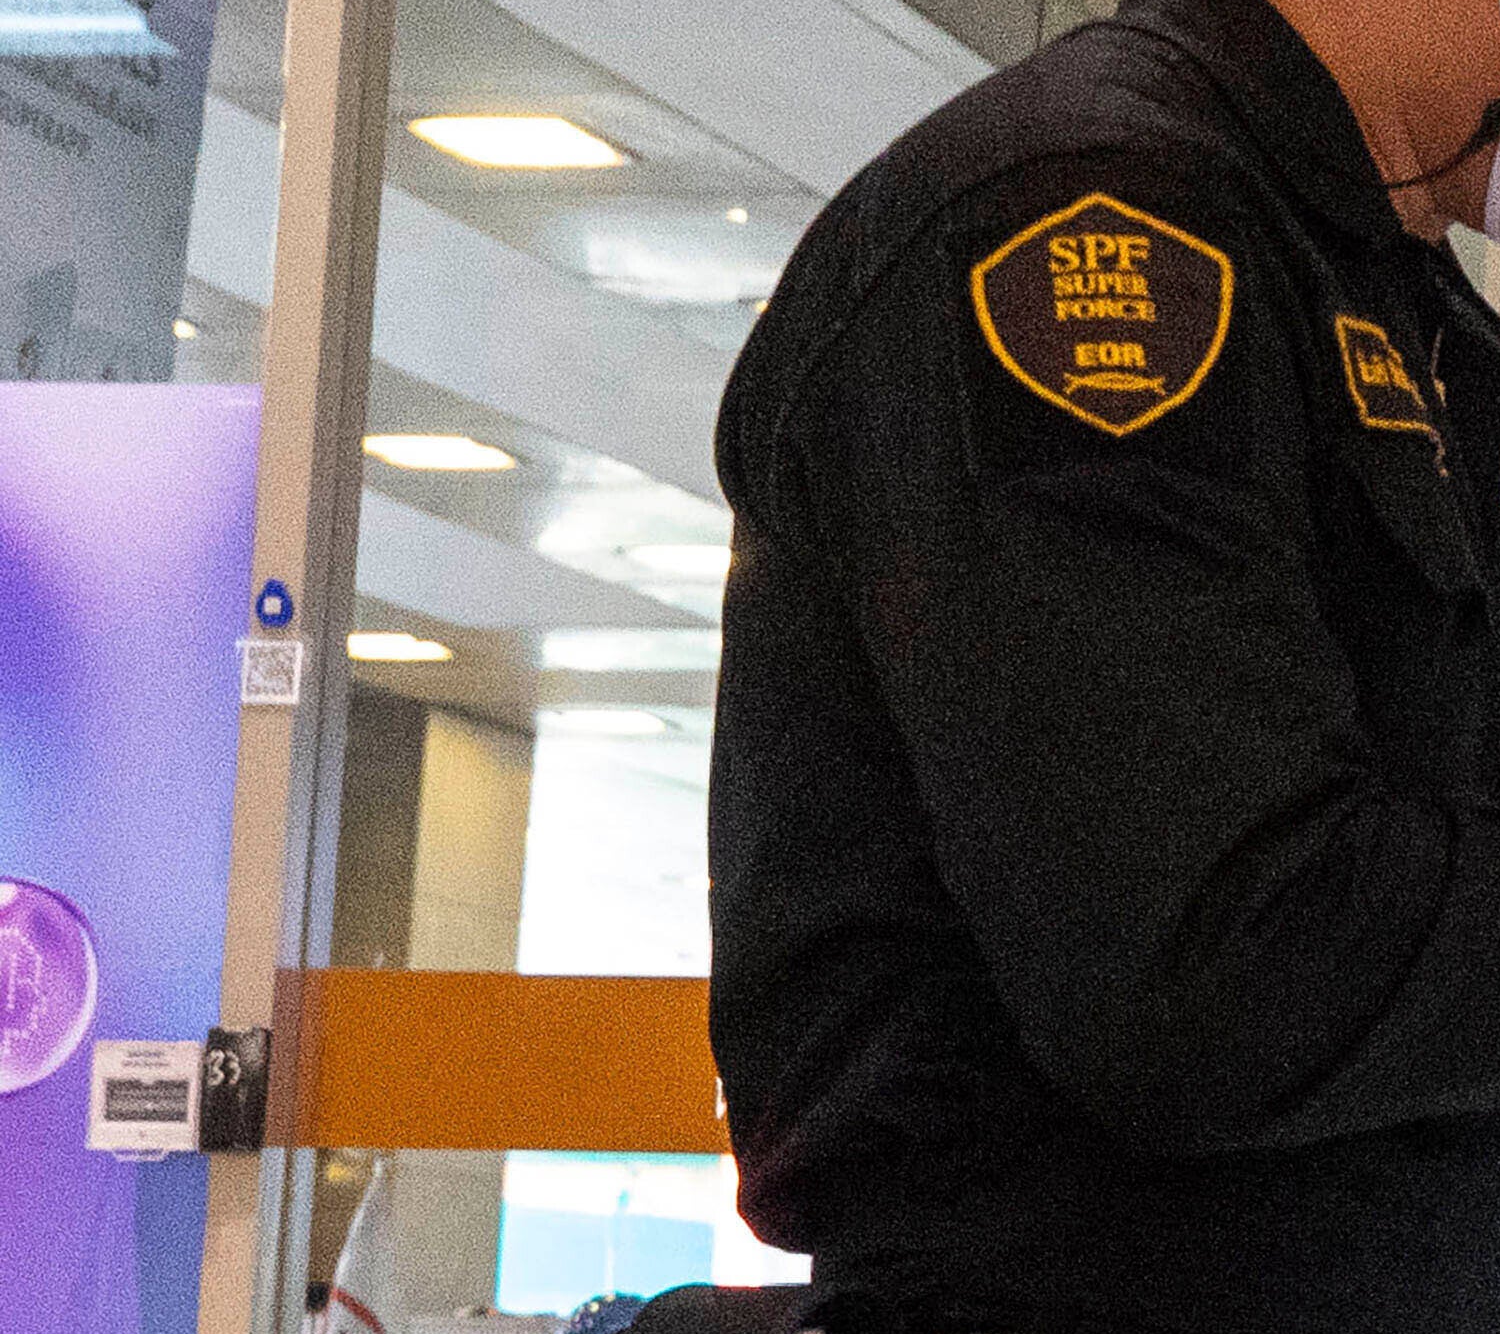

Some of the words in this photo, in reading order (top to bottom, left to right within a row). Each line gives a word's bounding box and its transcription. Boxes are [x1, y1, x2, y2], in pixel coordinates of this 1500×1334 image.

[1048, 233, 1150, 273] SPF
[1053, 271, 1149, 297] SUPER
[1055, 298, 1157, 322] FORCE
